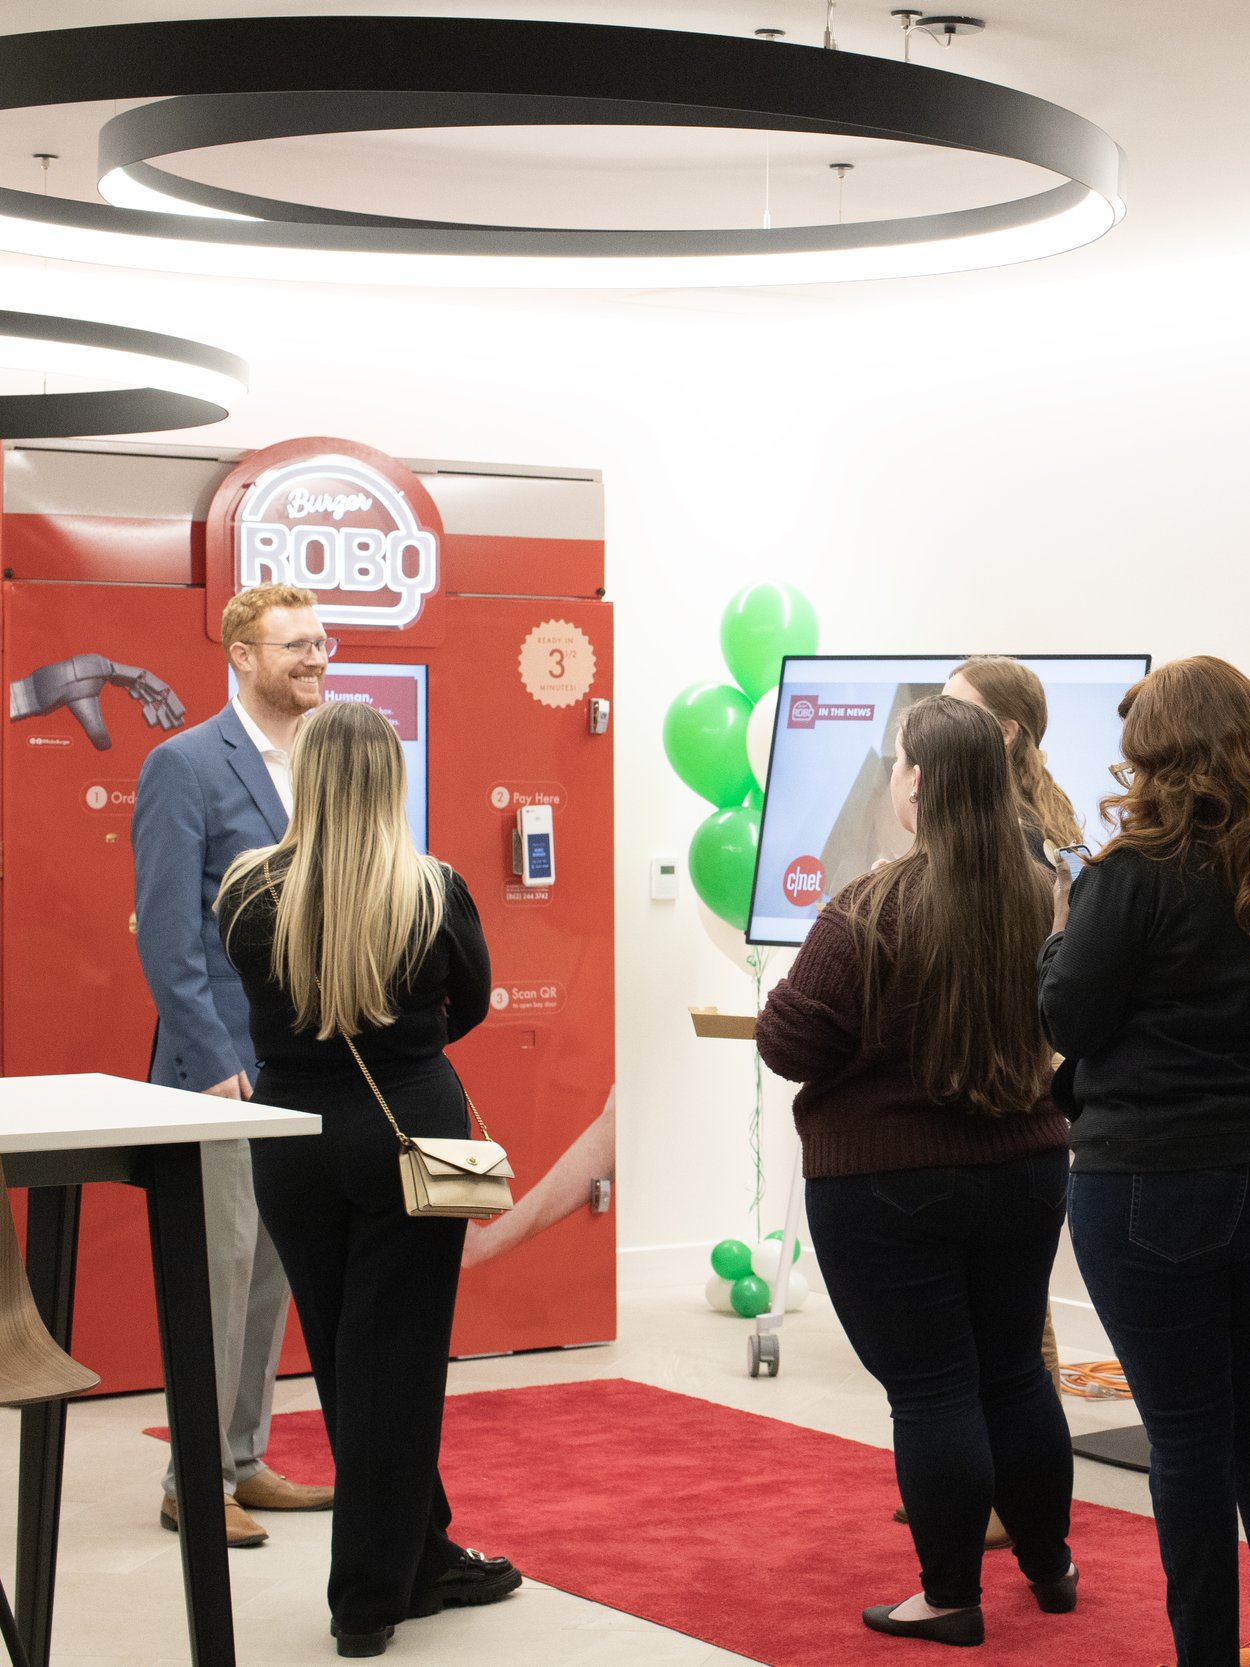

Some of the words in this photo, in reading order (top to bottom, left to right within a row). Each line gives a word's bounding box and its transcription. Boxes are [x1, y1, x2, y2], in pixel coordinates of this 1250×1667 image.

[287, 488, 372, 520] Burger
[241, 522, 437, 591] ROBO
[548, 648, 565, 679] 3
[539, 684, 577, 692] MINUTES!
[324, 690, 373, 704] Human,
[818, 707, 829, 716] IN
[830, 707, 846, 717] THE
[846, 707, 872, 717] NEWS
[111, 790, 136, 805] Ord
[497, 791, 504, 803] 2
[513, 791, 532, 806] Pay
[535, 791, 560, 804] Here
[496, 992, 503, 1004] 3
[512, 987, 537, 1000] Scan
[540, 986, 557, 999] QR
